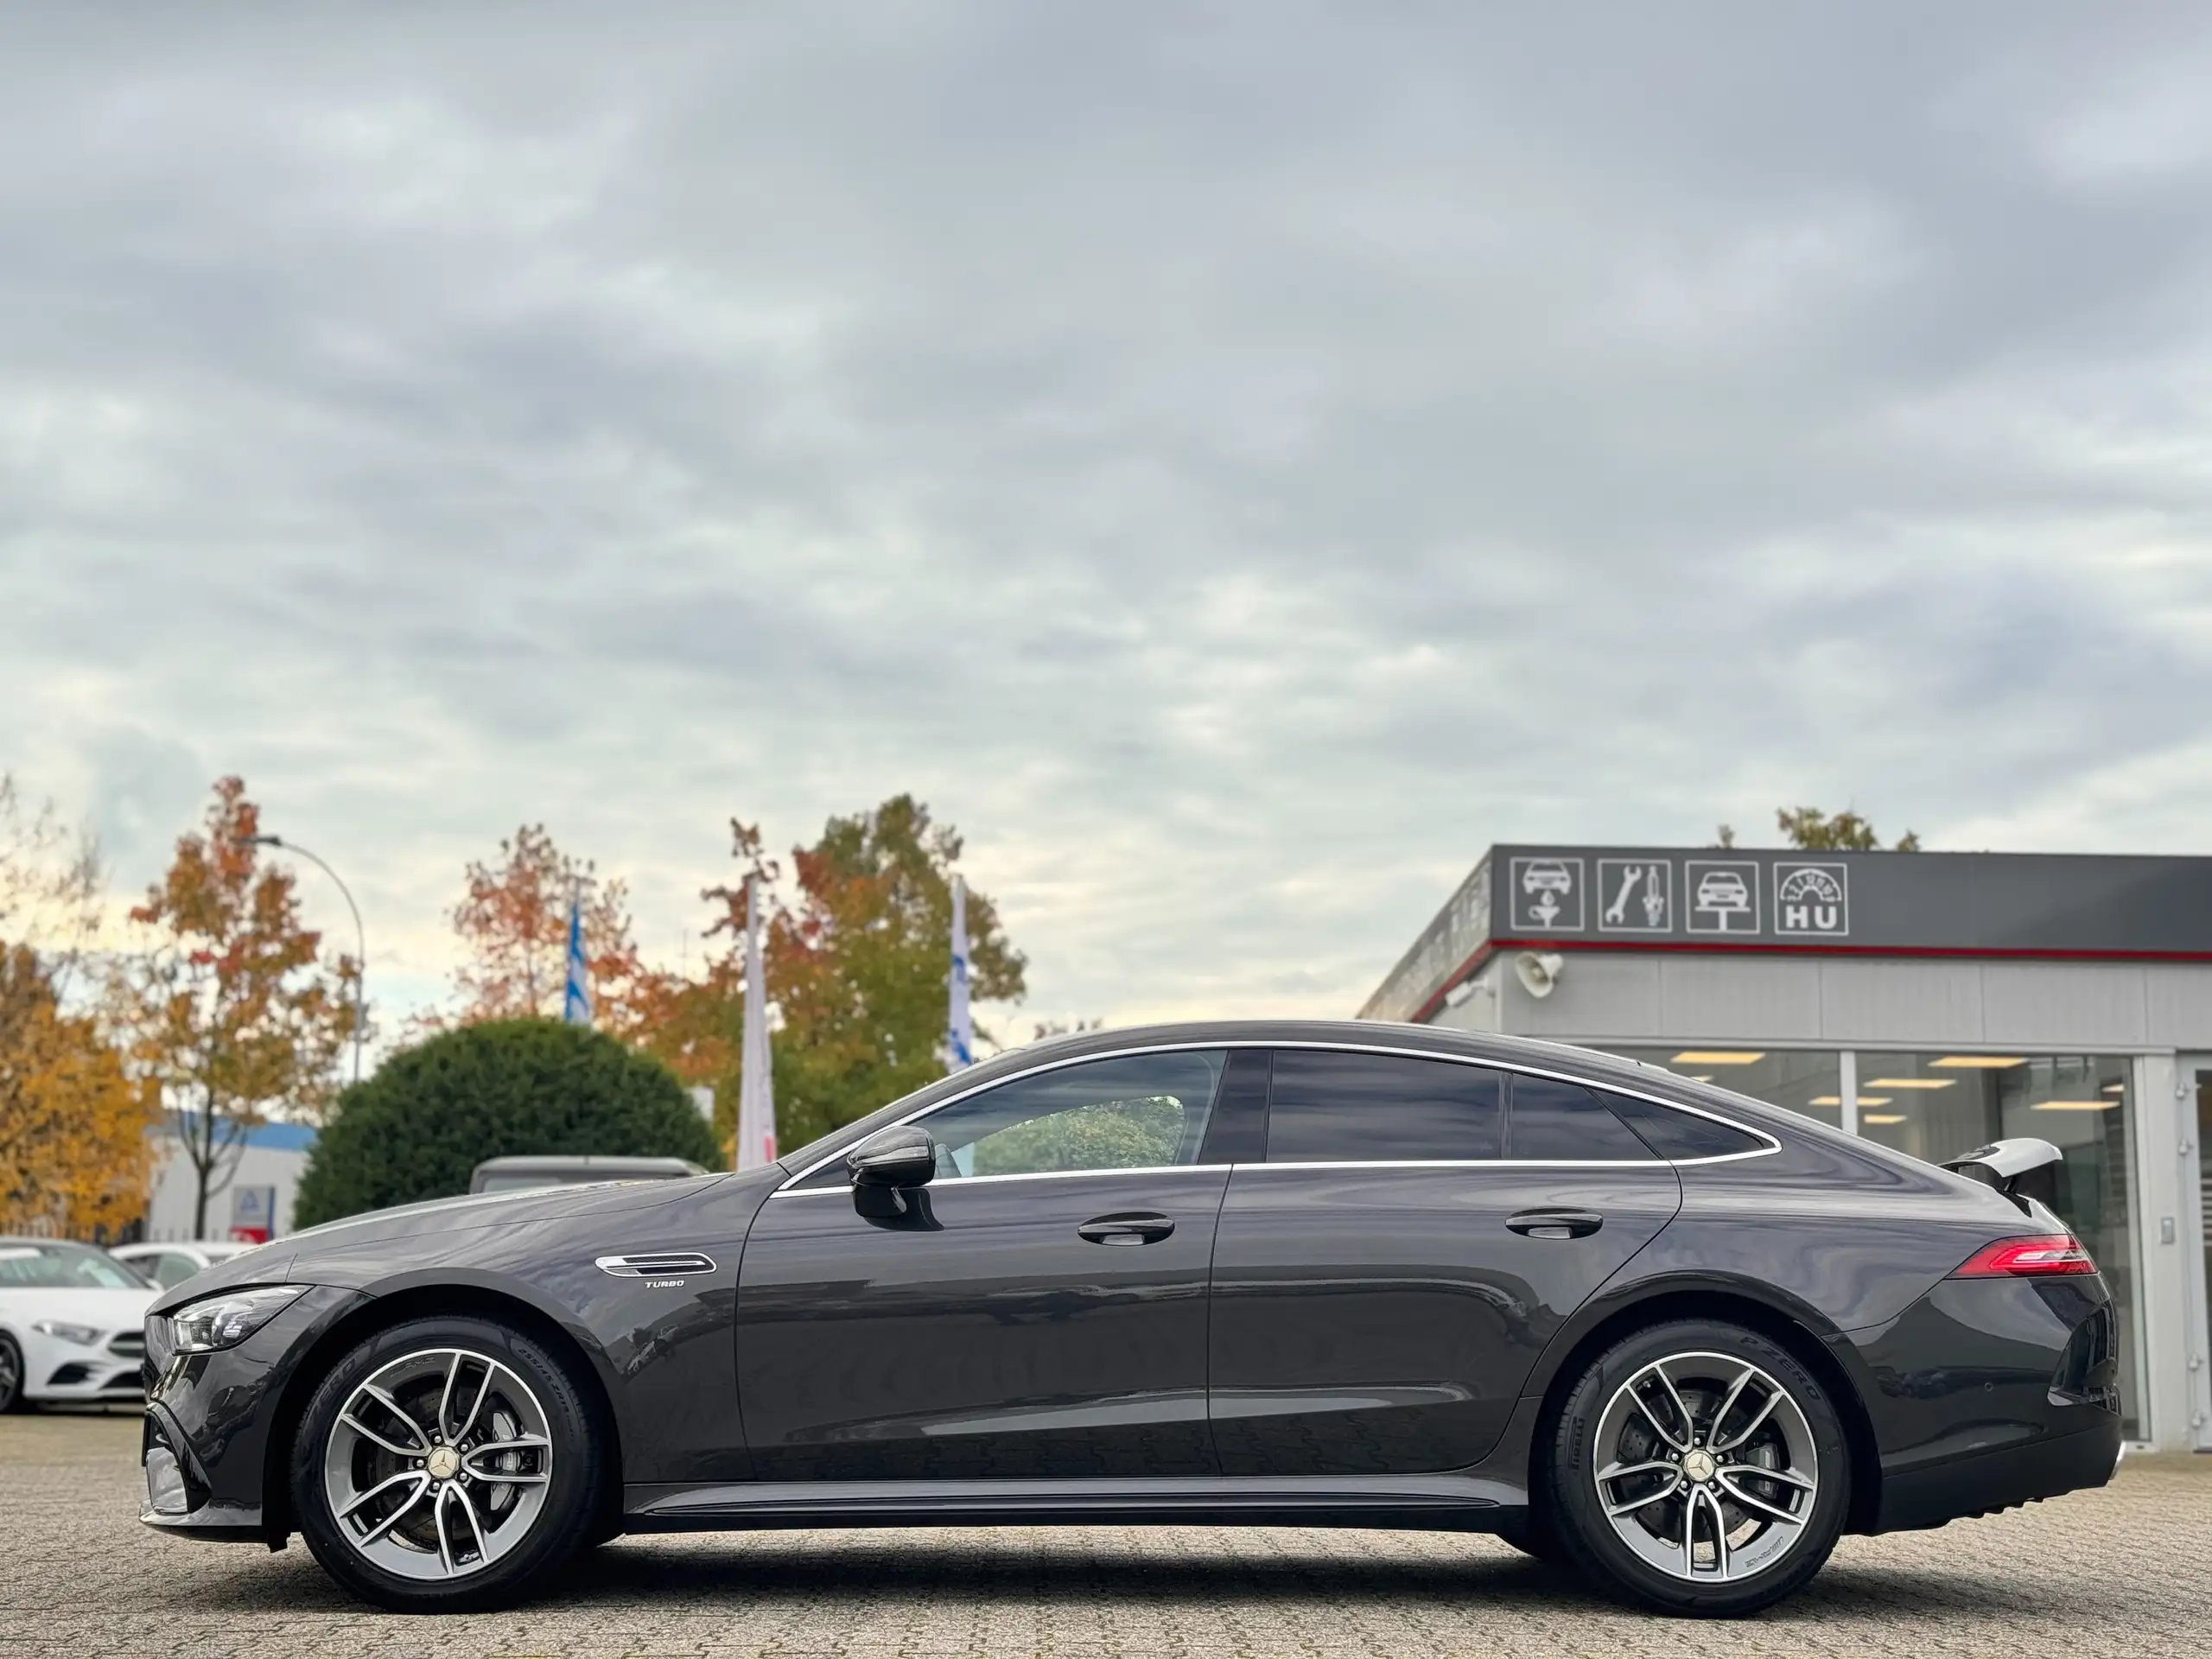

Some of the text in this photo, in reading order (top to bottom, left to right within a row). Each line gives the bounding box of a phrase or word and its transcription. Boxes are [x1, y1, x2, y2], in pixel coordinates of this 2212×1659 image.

[1786, 906, 1837, 929] HU
[645, 1280, 685, 1289] TURBO
[1760, 1346, 1821, 1400] ZERO
